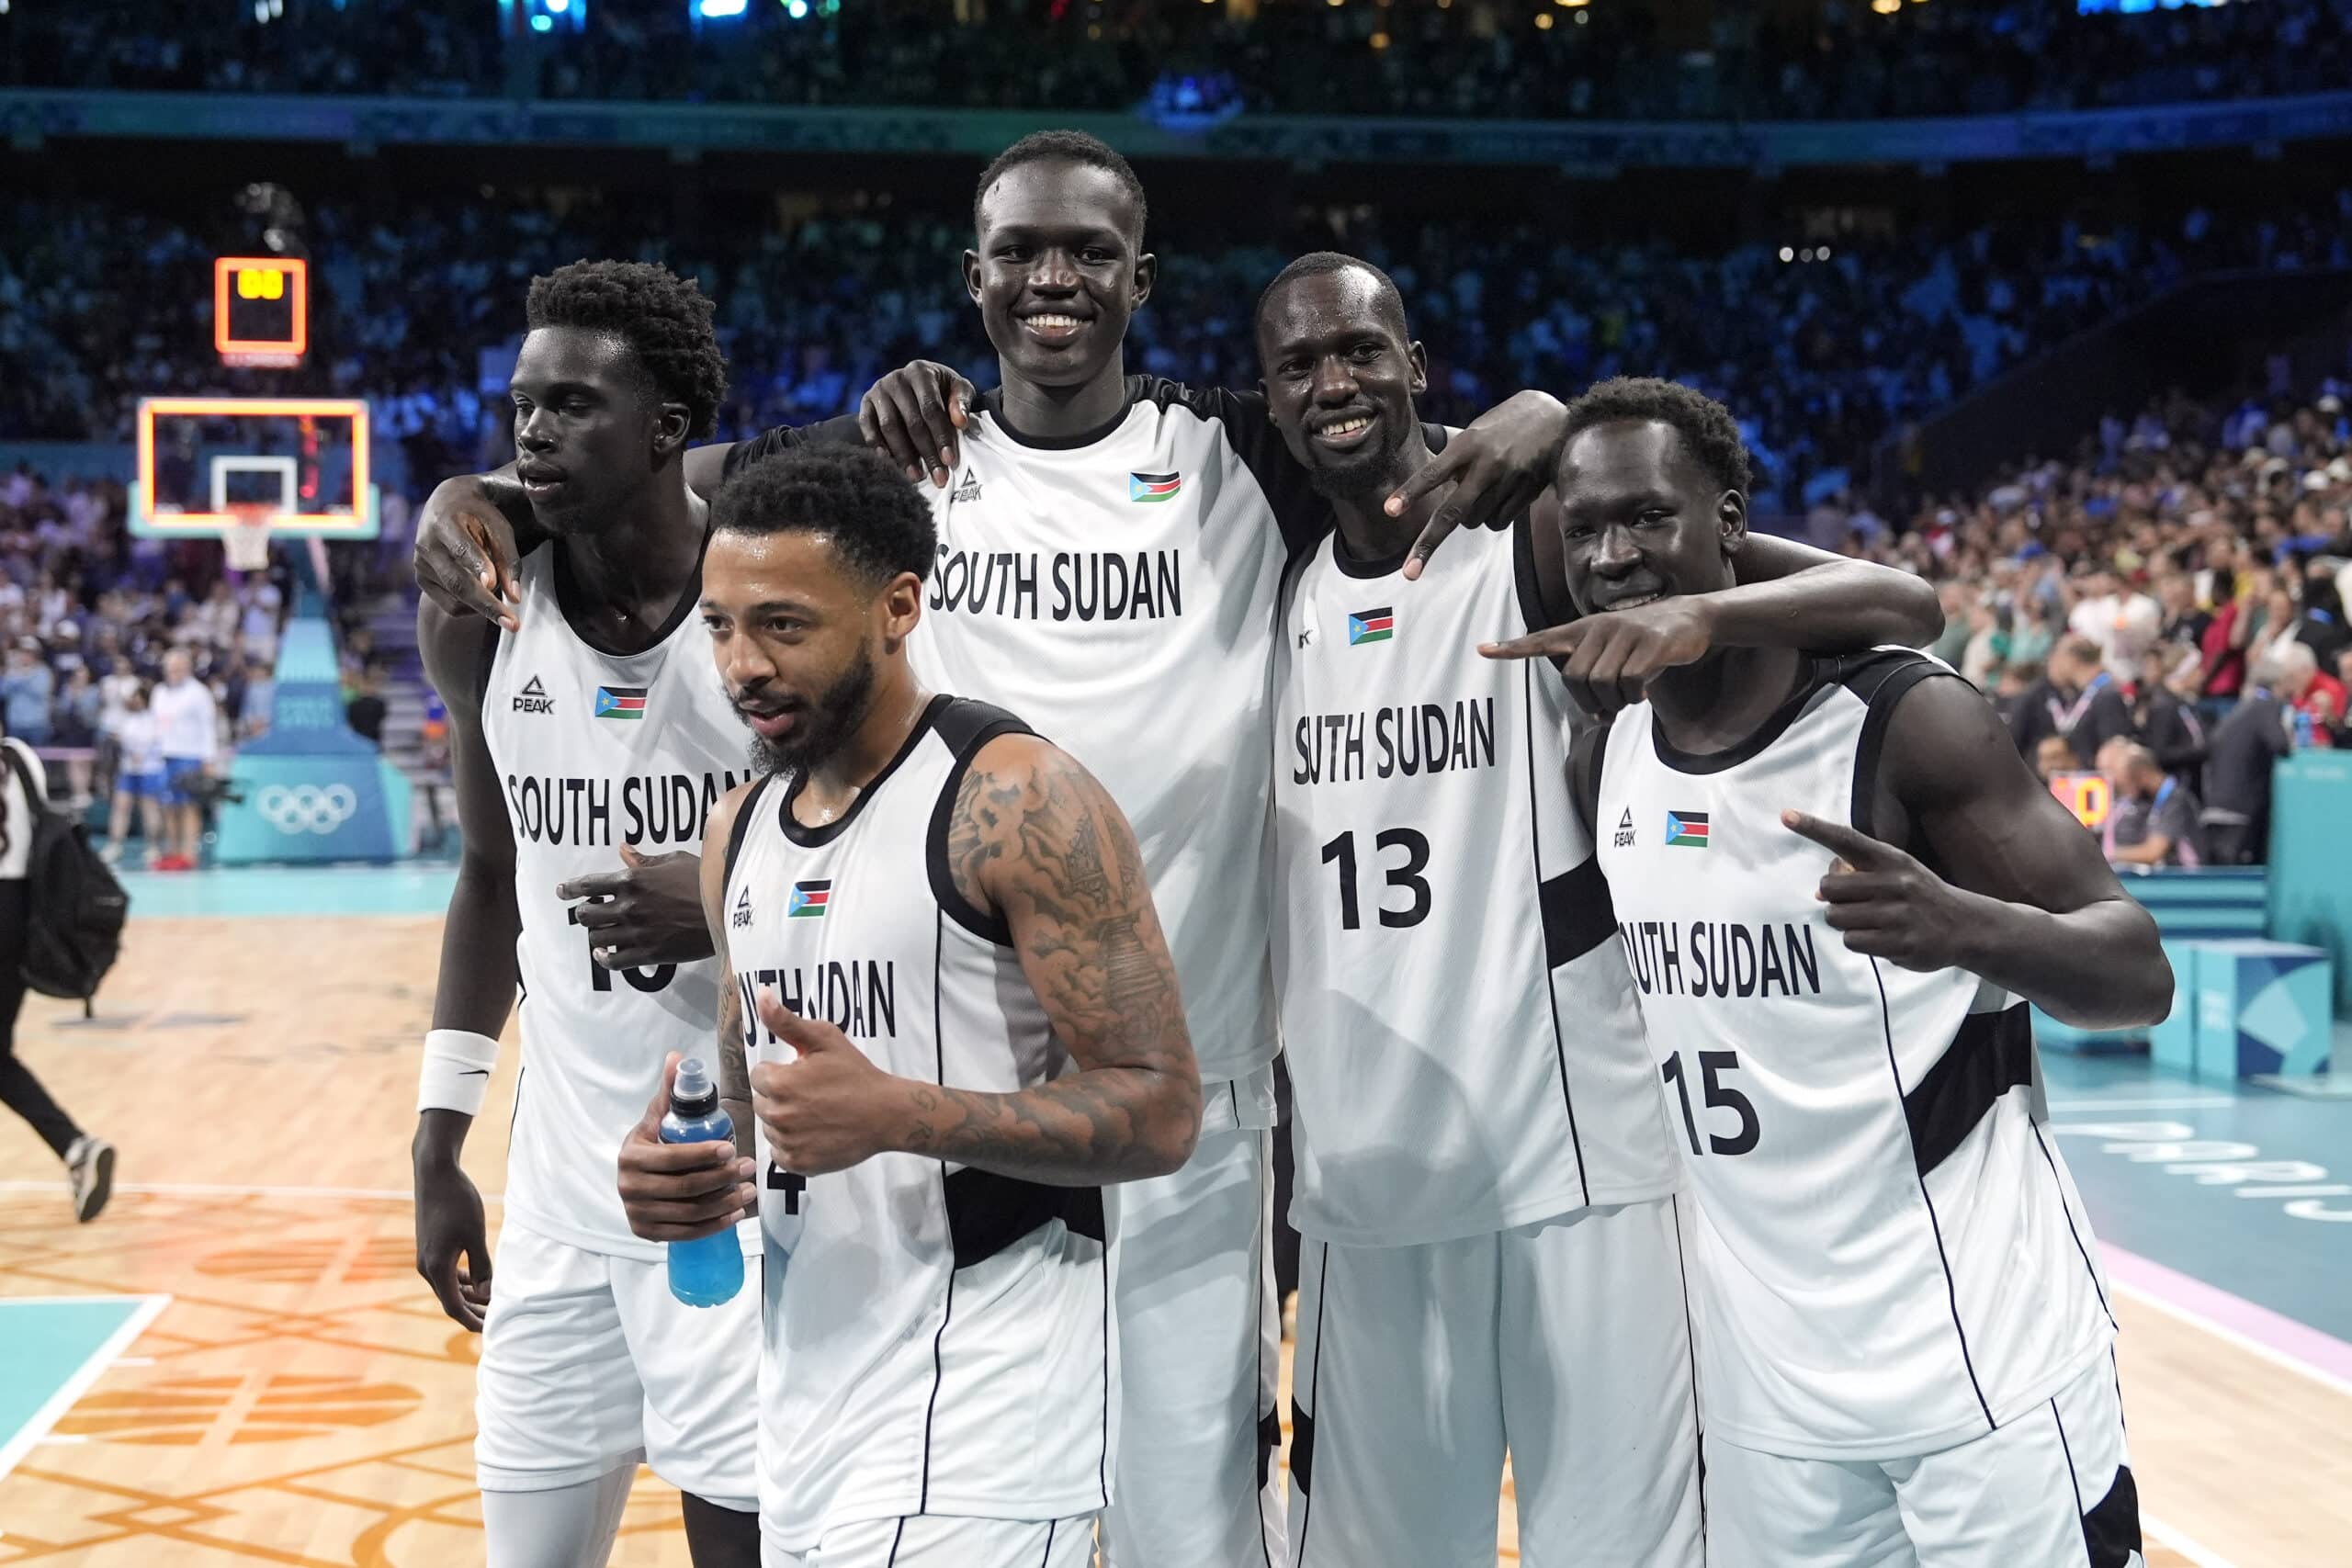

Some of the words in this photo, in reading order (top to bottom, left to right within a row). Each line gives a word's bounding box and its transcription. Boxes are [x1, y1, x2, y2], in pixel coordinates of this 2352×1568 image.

[930, 544, 1037, 620] SOUTH
[1052, 549, 1182, 622] SUDAN
[513, 697, 557, 715] PEAK
[1376, 696, 1496, 779] SUDAN
[508, 773, 610, 846] SOUTH
[622, 769, 751, 845] SUDA
[1613, 829, 1637, 848] PEAK
[1322, 828, 1432, 931] 13
[1690, 920, 1820, 998] SUDAN
[1661, 1050, 1761, 1156] 15
